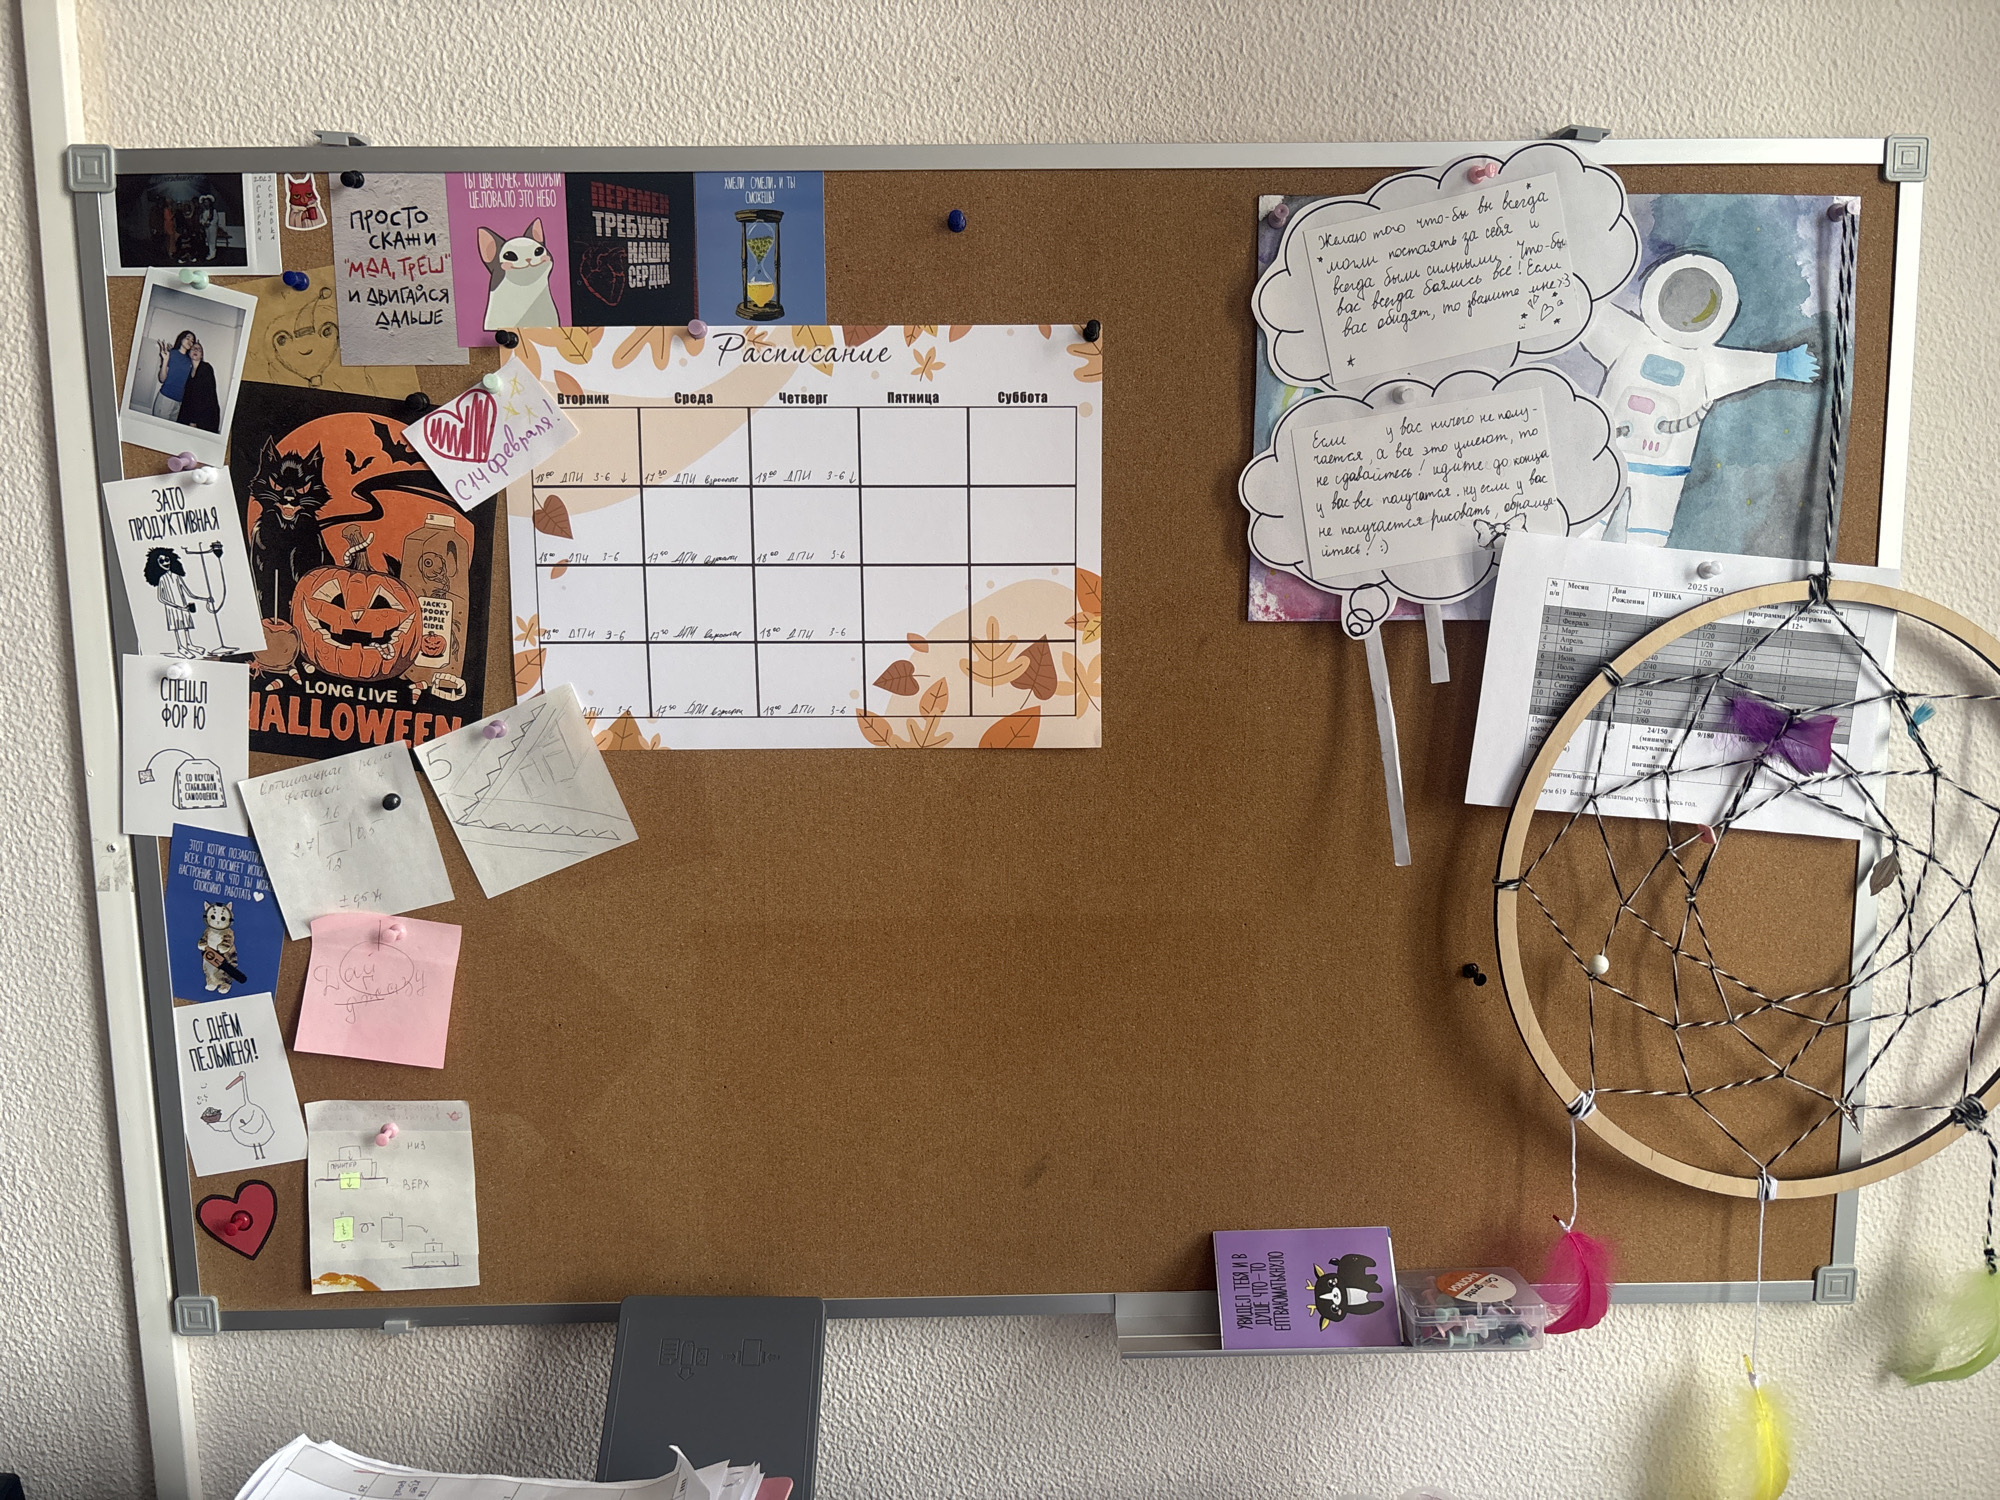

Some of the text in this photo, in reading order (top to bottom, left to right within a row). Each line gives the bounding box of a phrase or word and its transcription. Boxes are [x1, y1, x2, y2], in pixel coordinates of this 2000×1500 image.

[724, 176, 745, 190] ХМЕЛИ
[779, 176, 783, 189] И
[786, 176, 796, 189] ТЫ
[468, 189, 557, 209] ЦЕЛОВАЛО ЭТО НЕБО
[590, 181, 670, 215] ПЕРЕМЕН
[350, 206, 429, 234] ПРОСТО
[591, 211, 670, 239] ТРЕБУЮТ
[1318, 230, 1367, 250] Желаю
[1372, 223, 1406, 240] того
[1477, 195, 1494, 214] вы
[1502, 189, 1549, 214] всегда
[369, 231, 436, 250] СКАЖИ
[1326, 256, 1379, 274] могли
[1461, 230, 1479, 256] за
[1485, 216, 1513, 239] себя
[1529, 219, 1540, 229] и
[627, 241, 671, 264] НАШИ
[628, 264, 671, 290] СЕРДЦА
[1333, 275, 1375, 301] всегда
[1383, 266, 1421, 287] были
[348, 284, 450, 306] И ДВИГАЙСЯ
[1336, 296, 1361, 316] вас
[1372, 290, 1414, 312] всегда
[1527, 258, 1561, 276] Если
[375, 309, 444, 330] ДАЛЬШЕ
[1342, 316, 1367, 337] вас
[1443, 302, 1460, 314] то
[712, 332, 892, 367] Расписание
[557, 393, 610, 405] Вторник
[674, 392, 713, 405] Среда
[778, 392, 828, 405] Четверг
[887, 392, 940, 405] Пятница
[997, 391, 1048, 405] Суббота
[1312, 414, 1494, 448] Если у вас ничего не
[1395, 442, 1414, 459] все
[1422, 443, 1448, 456] это
[1519, 428, 1538, 439] то
[559, 472, 611, 484] ДПИ 3-6
[783, 469, 846, 482] ДПИ 3-6
[1316, 476, 1329, 487] не
[1433, 460, 1484, 482] идите
[1493, 458, 1508, 475] до
[1513, 450, 1550, 466] конца
[673, 472, 697, 485] ДПИ
[152, 486, 186, 513] ЗАТО
[1316, 502, 1325, 518] у
[1331, 491, 1350, 510] вас
[1353, 490, 1373, 510] все
[1480, 482, 1510, 493] если
[1516, 481, 1524, 495] у
[1529, 468, 1548, 485] вас
[128, 506, 220, 542] ПРОДУКТИВНАЯ
[1319, 527, 1332, 537] не
[1567, 582, 1590, 591] Месяц
[1612, 587, 1627, 595] Дни
[1652, 591, 1682, 601] ПУШКА
[1687, 582, 1725, 594] 2025 год
[1611, 596, 1645, 606] Рождения
[423, 615, 445, 623] APPLE
[1562, 618, 1589, 627] Февраль
[1563, 609, 1587, 618] Январь
[1748, 611, 1786, 620] программа
[423, 622, 444, 630] CIDER
[1561, 626, 1579, 635] Март
[1559, 644, 1573, 653] Май
[1560, 636, 1584, 645] Апрель
[1558, 654, 1576, 662] Июнь
[1555, 671, 1577, 681] Август
[160, 677, 208, 704] СПЕШЛ
[304, 680, 398, 704] LONG LIVE
[161, 704, 206, 730] ФОР Ю
[1647, 726, 1668, 735] 24/150
[426, 743, 453, 781] 5
[186, 774, 192, 782] СО
[189, 838, 227, 857] ЭТОТ КОТИК
[203, 855, 245, 874] КТО ПОСМЕЕТ
[215, 870, 225, 883] ТАК
[229, 874, 240, 886] ЧТО
[244, 876, 253, 888] ТЫ
[193, 879, 251, 901] СПОКОЙНО РАБОТАТЬ
[192, 1011, 244, 1044] С ДНЁМ
[188, 1037, 260, 1072] ПЕЛЬМЕНЯ!
[402, 1178, 430, 1191] ВЕРХ
[1232, 1271, 1250, 1291] ТЕБЯ
[1235, 1294, 1254, 1330] УВИДЕЛ
[1253, 1301, 1273, 1326] ДУШЕ
